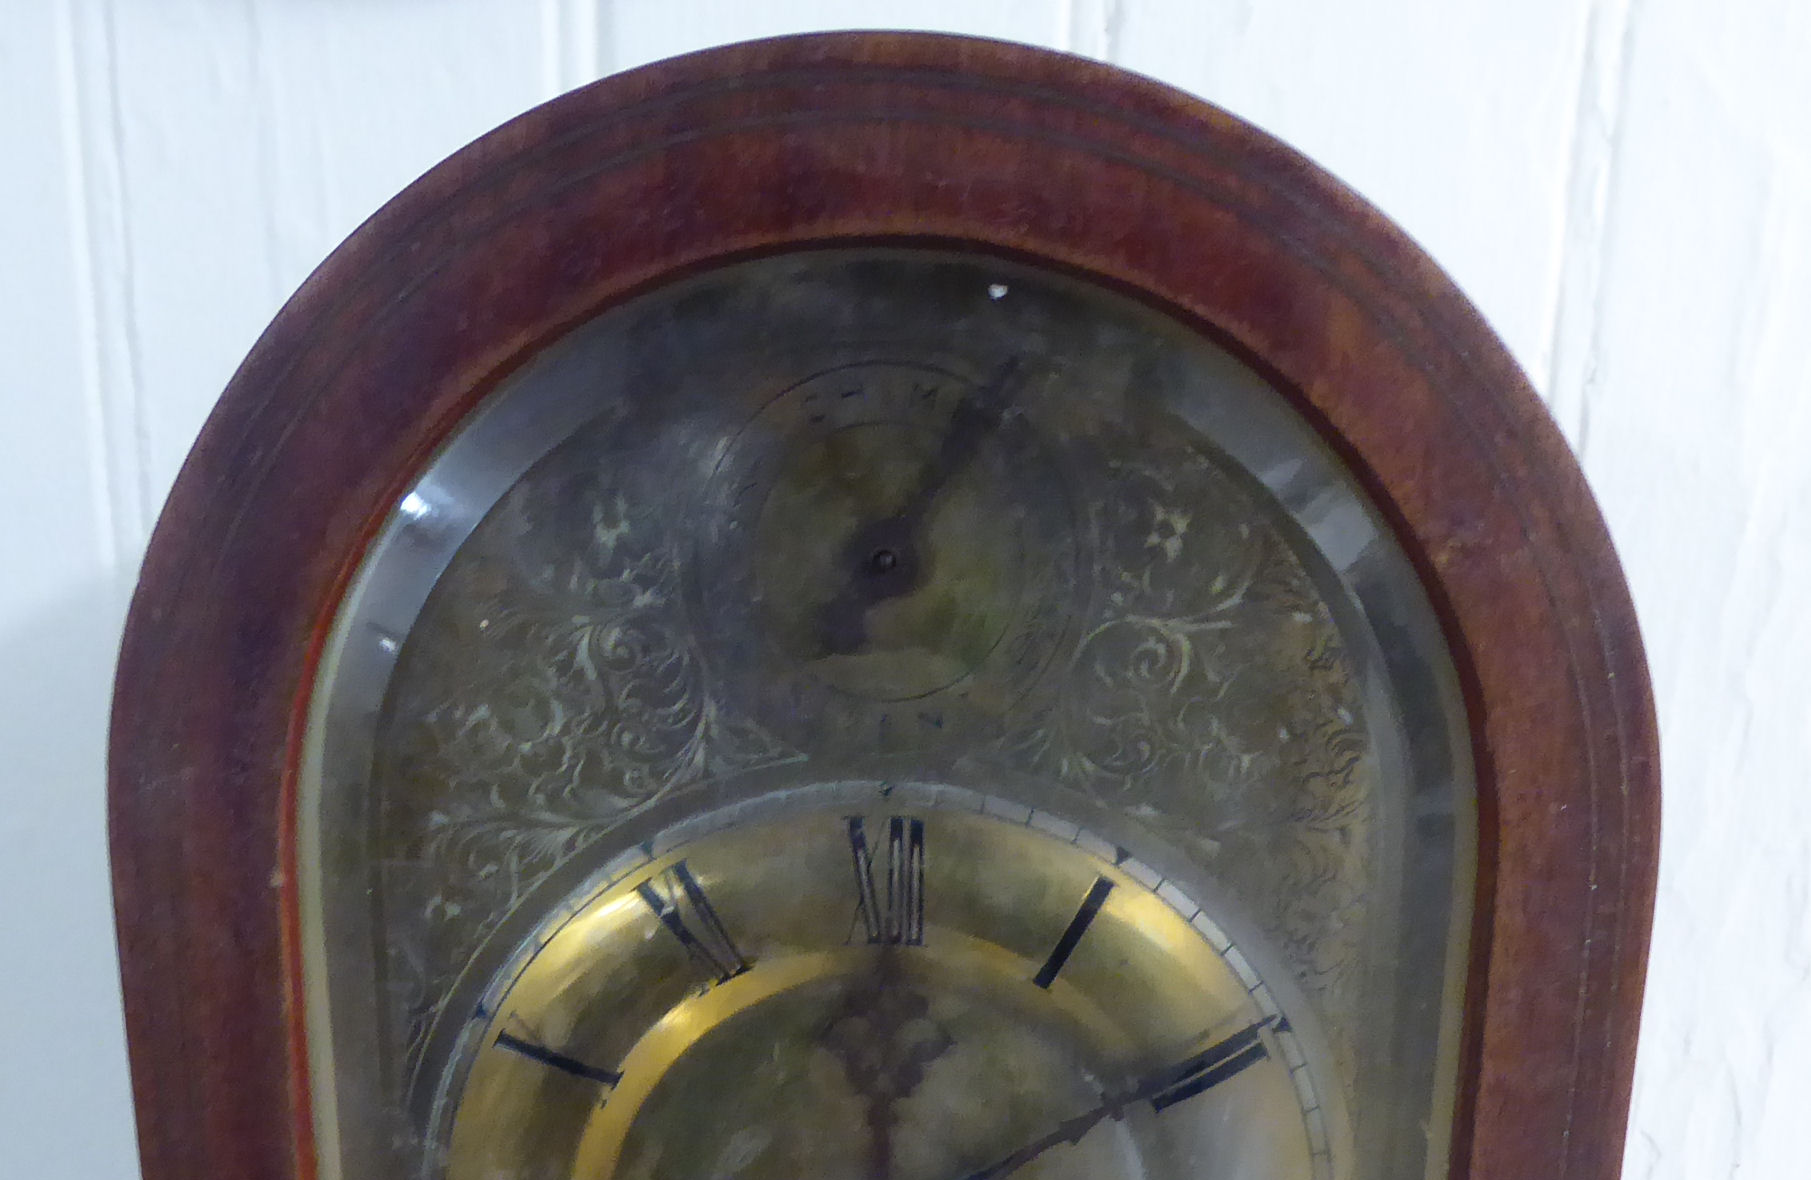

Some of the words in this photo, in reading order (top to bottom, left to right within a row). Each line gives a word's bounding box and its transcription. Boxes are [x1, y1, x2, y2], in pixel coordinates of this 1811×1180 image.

[630, 857, 757, 986] XI
[843, 816, 925, 945] XII
[1032, 876, 1115, 989] I
